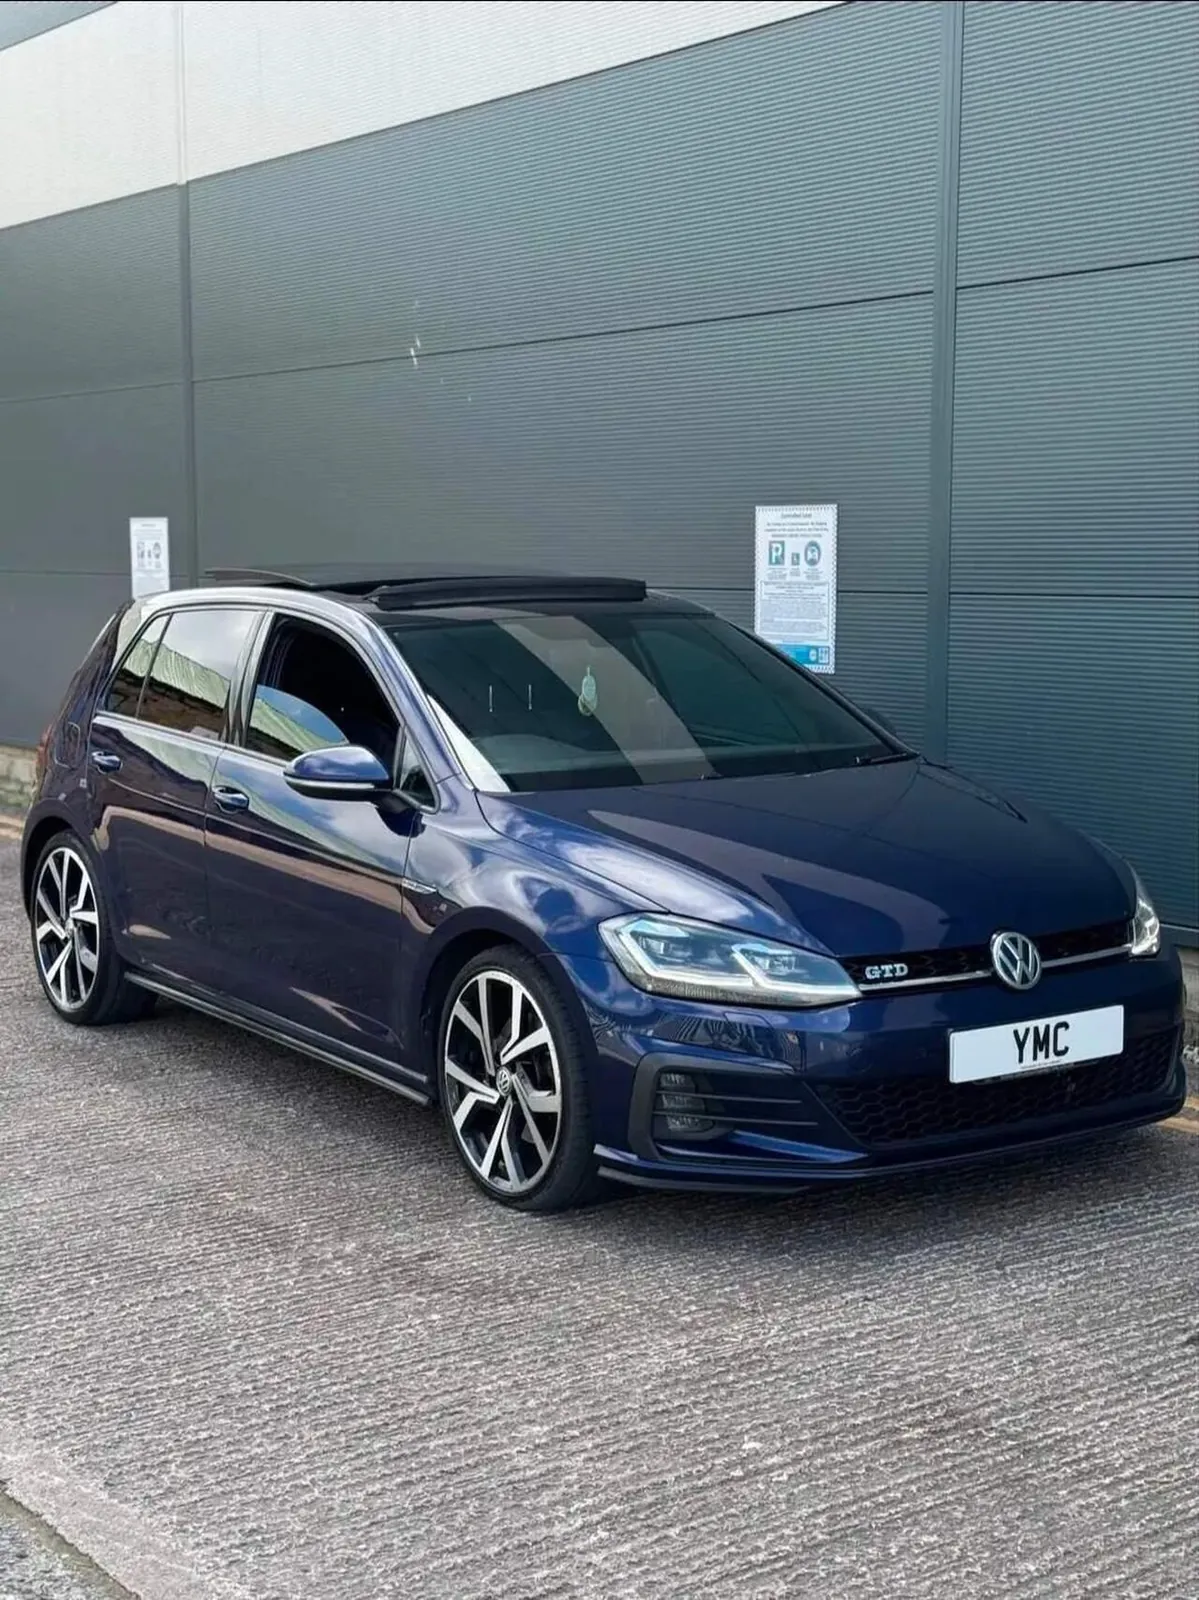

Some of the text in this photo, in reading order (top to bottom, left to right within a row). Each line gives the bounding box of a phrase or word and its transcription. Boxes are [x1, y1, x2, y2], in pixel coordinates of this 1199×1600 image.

[865, 963, 909, 979] GTD
[995, 933, 1040, 988] VW
[1013, 1021, 1070, 1064] YMC
